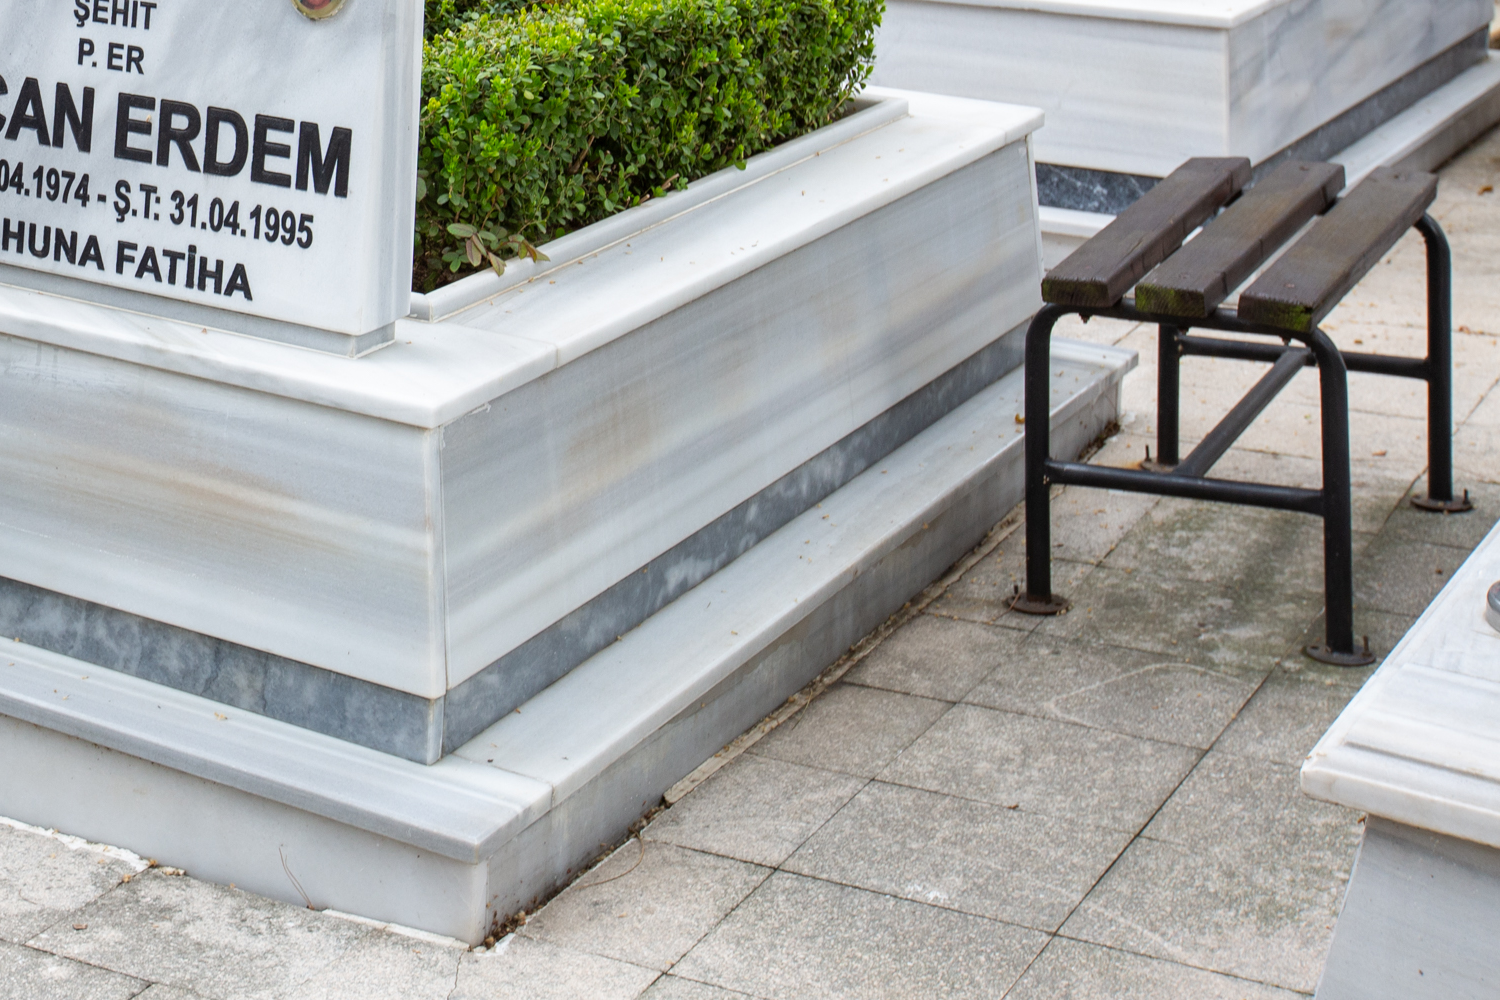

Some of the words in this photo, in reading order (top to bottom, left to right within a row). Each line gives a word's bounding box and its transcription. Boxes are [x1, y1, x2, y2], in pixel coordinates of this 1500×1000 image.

[78, 38, 97, 67] P.
[107, 42, 144, 75] ER
[114, 92, 352, 199] ERDEM
[113, 180, 160, 223] Ş.T:
[169, 189, 314, 249] 31.04.1995
[115, 241, 253, 301] FATİHA
